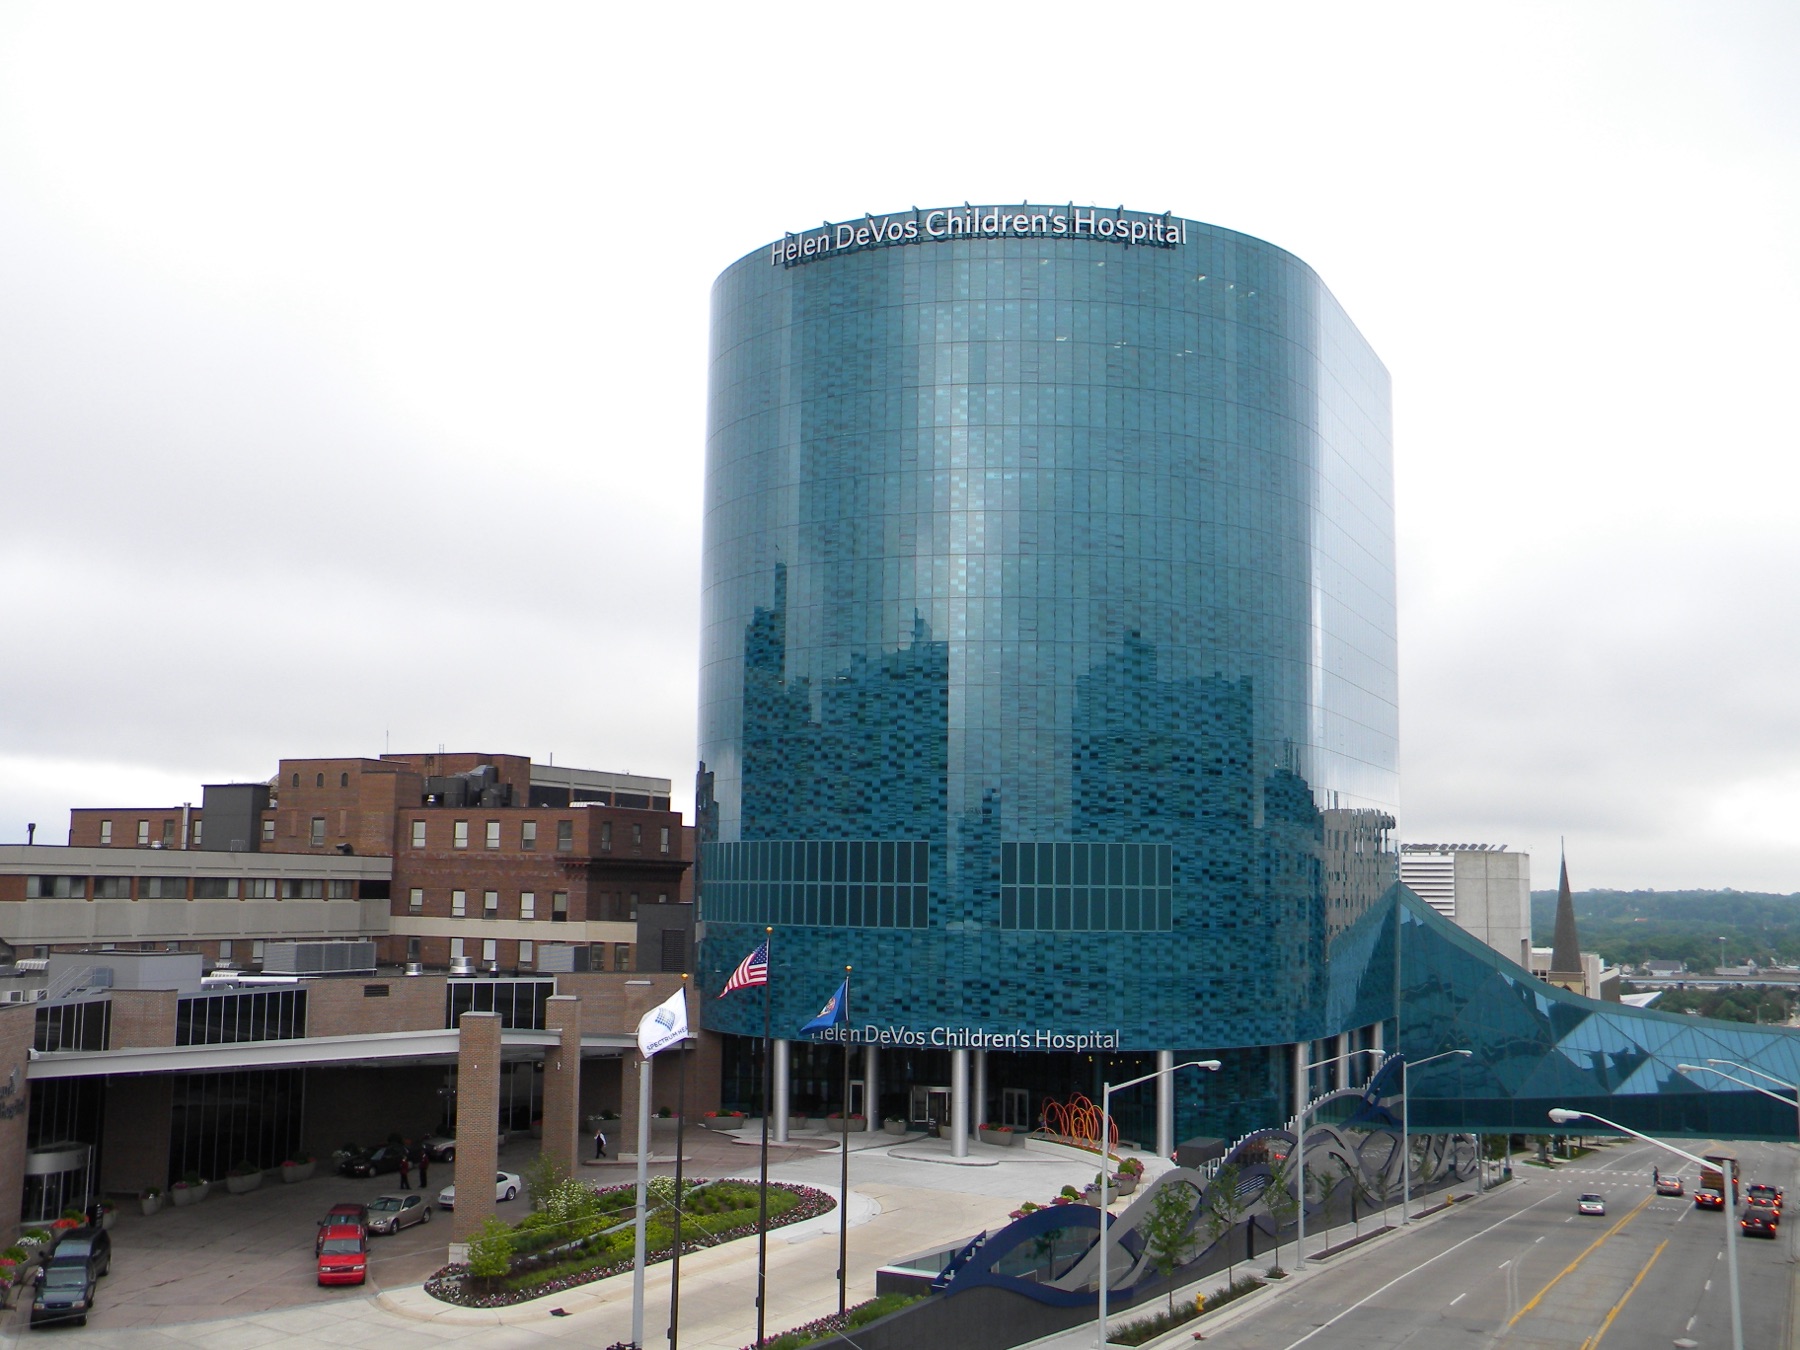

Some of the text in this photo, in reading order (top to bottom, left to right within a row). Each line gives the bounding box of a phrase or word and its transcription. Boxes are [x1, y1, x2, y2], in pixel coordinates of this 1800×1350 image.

[771, 207, 1187, 266] Helen DeVos Children's Hospital
[646, 1031, 678, 1051] SPECTRUM
[865, 1024, 926, 1045] DeVos
[931, 1027, 1031, 1048] Children's
[1035, 1029, 1119, 1053] Hospital
